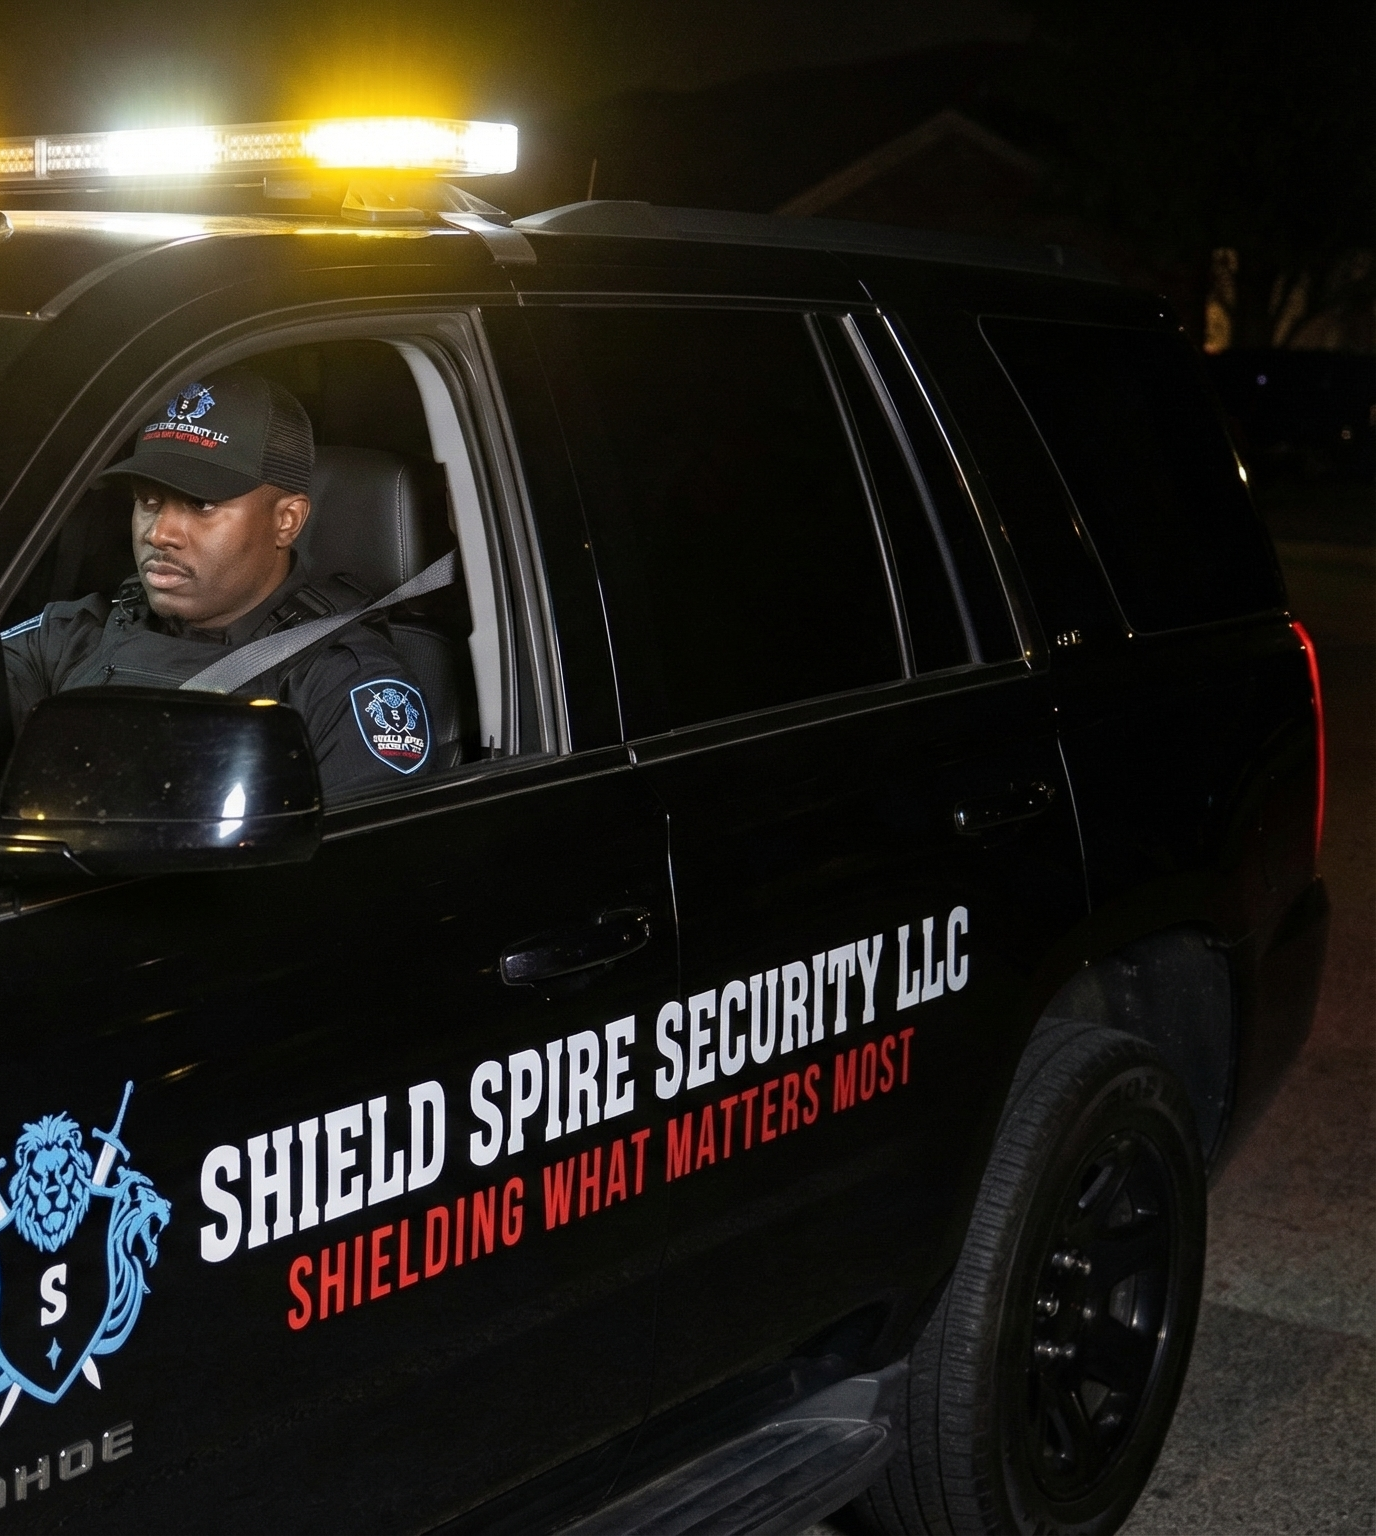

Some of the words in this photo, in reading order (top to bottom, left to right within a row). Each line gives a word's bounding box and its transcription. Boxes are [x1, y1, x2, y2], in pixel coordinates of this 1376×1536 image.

[199, 1079, 447, 1264] SHIELD
[469, 1013, 637, 1168] SPIRE
[654, 932, 884, 1101] SECURITY
[896, 904, 970, 1025] LLC
[286, 1175, 525, 1331] SHIELDING
[543, 1127, 652, 1231] WHAT
[666, 1063, 821, 1182] MATTERS
[833, 1027, 914, 1112] MOST
[40, 1262, 69, 1327] S
